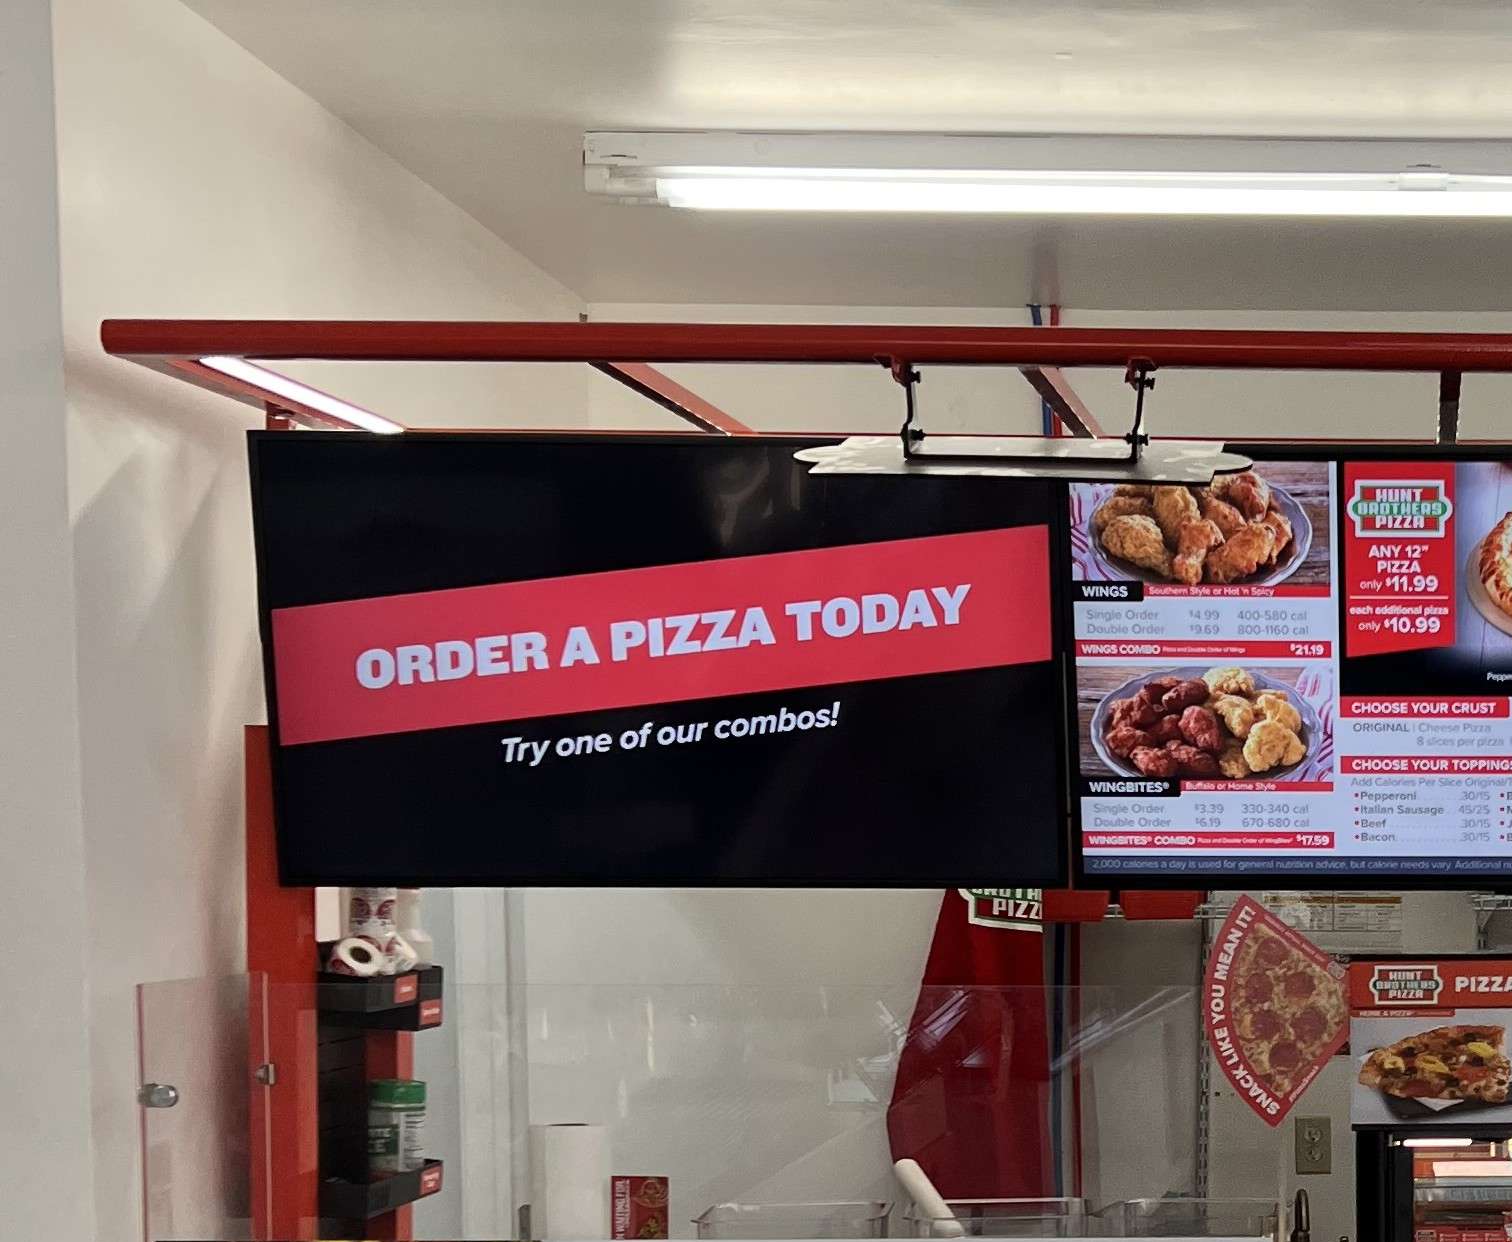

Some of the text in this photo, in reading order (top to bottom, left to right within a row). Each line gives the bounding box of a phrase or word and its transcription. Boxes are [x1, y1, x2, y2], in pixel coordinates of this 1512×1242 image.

[1375, 489, 1423, 502] HUNT
[1357, 502, 1442, 515] BROTHERS
[1375, 515, 1425, 529] PIZZA
[1368, 545, 1402, 558] ANY
[1377, 561, 1421, 573] PIZZA
[1359, 576, 1438, 592] only $11.99
[1082, 586, 1128, 598] WINGS
[1086, 610, 1122, 621] Single
[1124, 610, 1159, 621] Order
[1237, 610, 1287, 621] 400-580
[1350, 606, 1449, 616] each additional pizza
[1358, 617, 1440, 633] only $10.99
[355, 584, 972, 690] ORDER A PIZZA TODAY
[1081, 644, 1118, 655] WINGS
[1119, 644, 1161, 655] COMBO
[1290, 644, 1325, 655] $21.19
[1351, 702, 1497, 714] CHOOSE YOUR CRUST
[1352, 722, 1492, 733] ORIGINAL Cheese Pizza
[501, 701, 840, 768] Try one of our combos!
[1351, 759, 1409, 771] CHOOSE
[1410, 759, 1449, 771] YOUR
[1360, 791, 1417, 802] Pepperoni
[1093, 804, 1130, 814] Single
[1131, 804, 1165, 814] Order
[1241, 804, 1290, 814] 330-340
[1292, 804, 1309, 814] cal
[1360, 805, 1445, 815] Italian Sausage
[1360, 819, 1387, 829] Beef
[1154, 836, 1196, 846] COMBO
[1296, 836, 1330, 846] $17.59
[1360, 833, 1396, 842] Bacon
[1210, 905, 1281, 1115] SNACK LIKE YOU MEAN IT!
